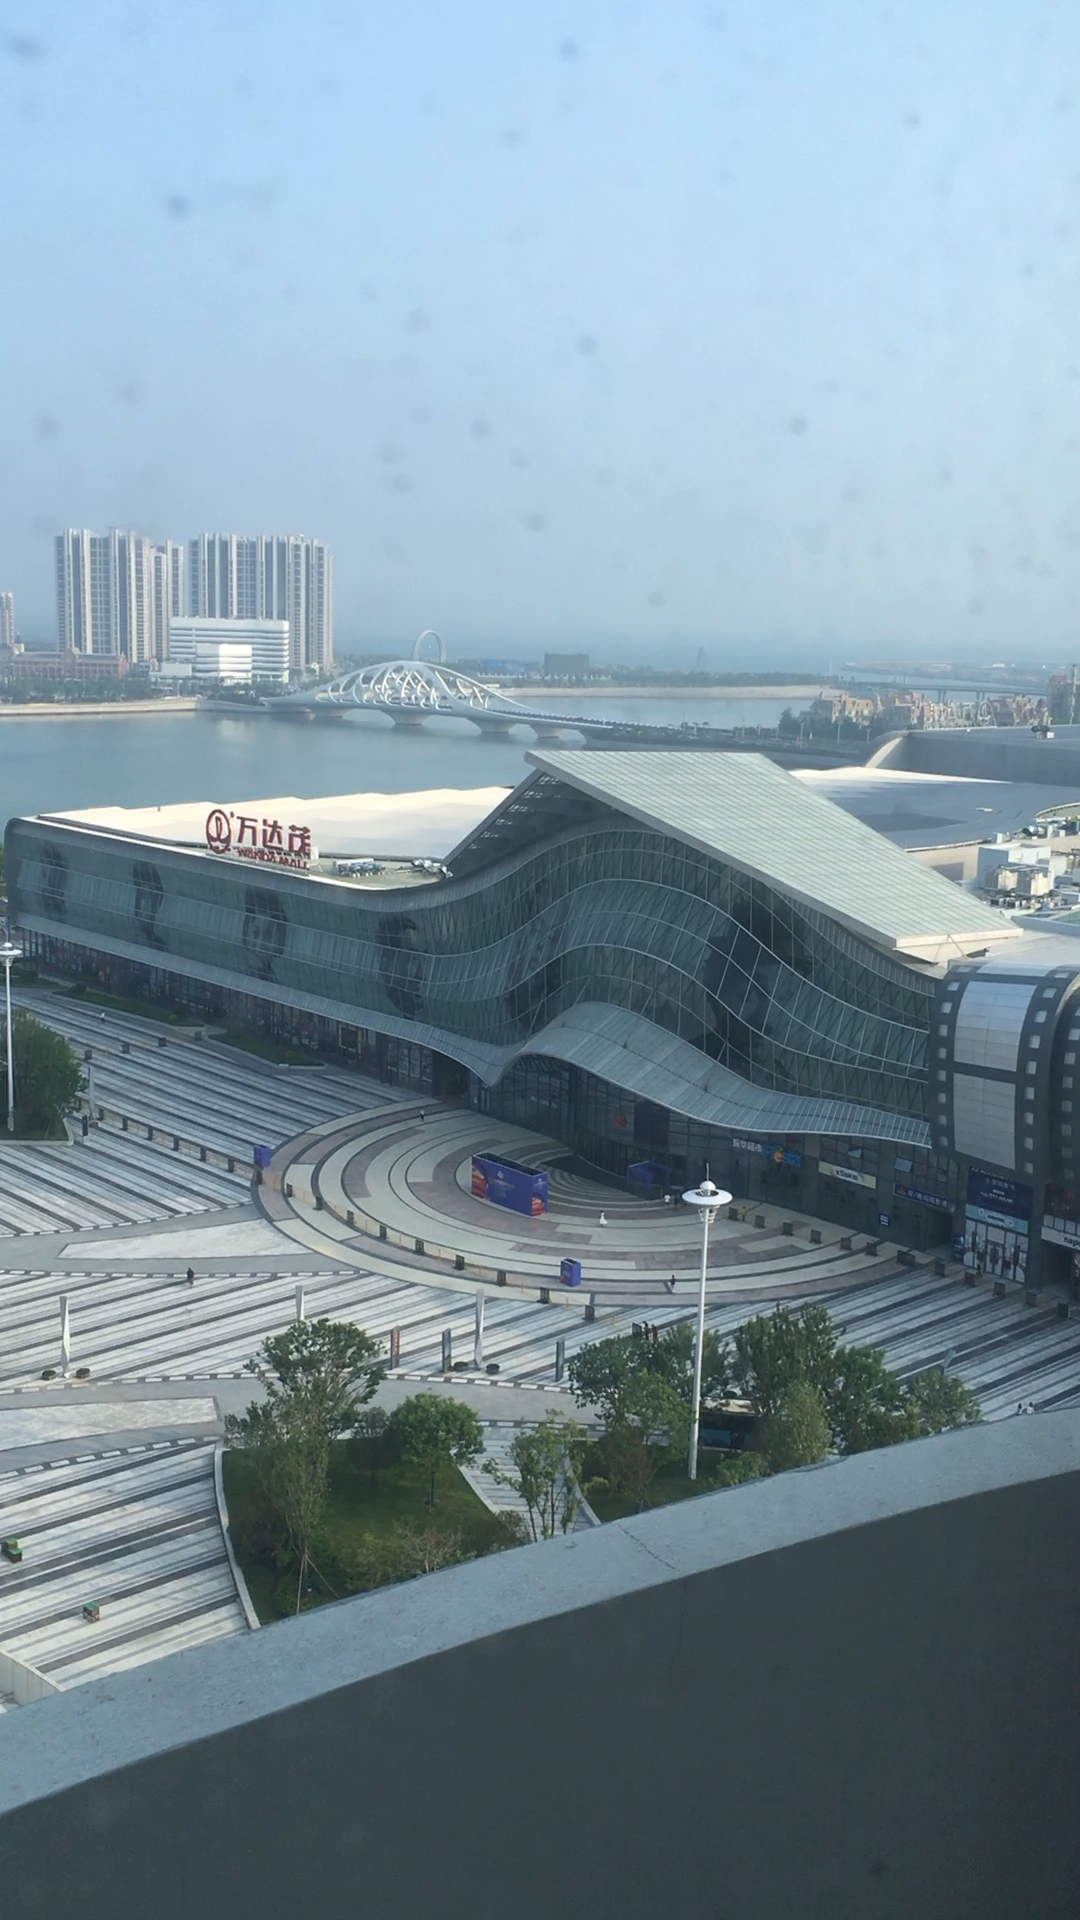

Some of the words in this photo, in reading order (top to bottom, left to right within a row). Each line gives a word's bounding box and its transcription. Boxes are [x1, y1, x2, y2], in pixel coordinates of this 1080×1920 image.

[236, 815, 311, 859] 万达茂
[237, 848, 276, 862] WANDA
[279, 856, 310, 870] MALL
